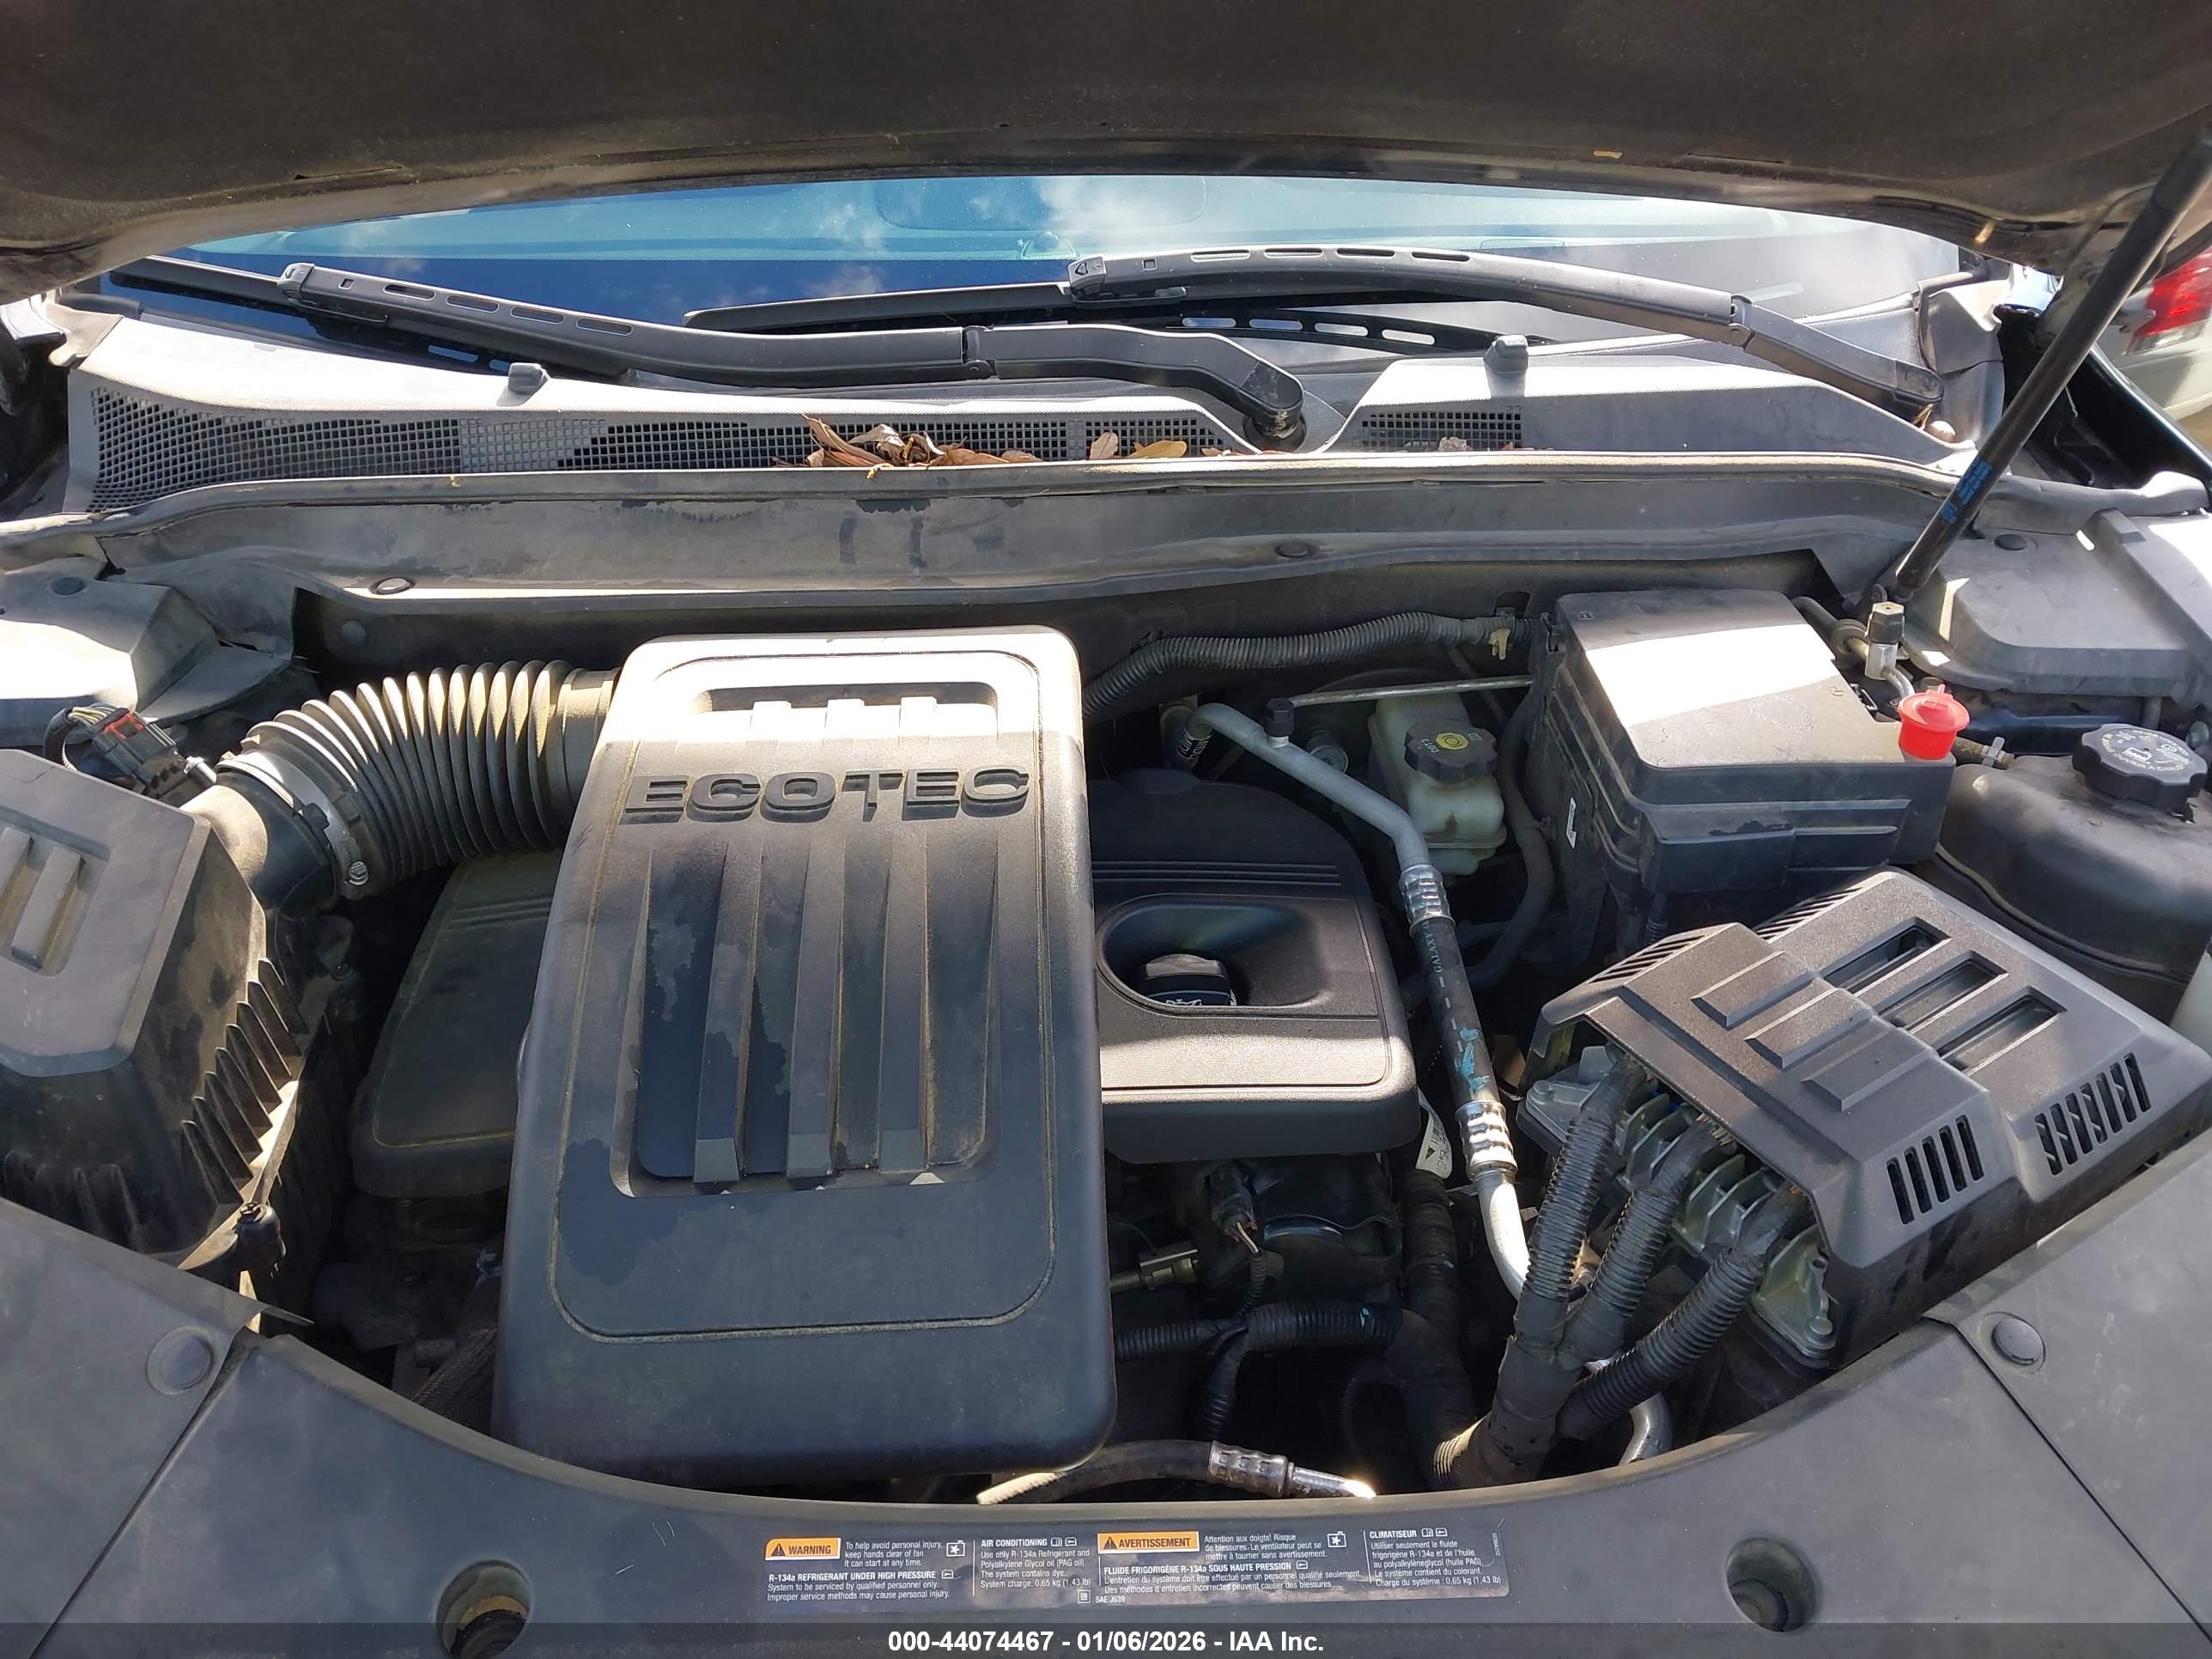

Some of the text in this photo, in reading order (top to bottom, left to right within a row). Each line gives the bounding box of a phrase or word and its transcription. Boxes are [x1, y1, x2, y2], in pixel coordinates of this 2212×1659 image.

[623, 765, 1029, 818] ECOTEC
[1425, 933, 1443, 973] GALAXY
[1273, 1534, 1296, 1542] Risque
[1370, 1530, 1417, 1539] CLIMATISEUR
[892, 1541, 921, 1550] personal
[1119, 1538, 1191, 1548] AVERTISSEMENT
[788, 1546, 831, 1554] WARNING
[845, 1551, 861, 1559] keep
[996, 1551, 1009, 1559] only
[981, 1561, 1022, 1570] Polyalkylene
[1024, 1560, 1046, 1570] Glycol
[1056, 1559, 1073, 1567] (PAG
[1104, 1566, 1129, 1575] FLUIDE
[1231, 1563, 1254, 1571] HAUTE
[1255, 1562, 1291, 1571] PRESSION
[798, 1572, 848, 1581] REFRIGERANT
[1052, 1569, 1066, 1578] dye.
[1104, 1576, 1139, 1584] L'entretien
[1152, 1574, 1180, 1584] système
[1182, 1573, 1195, 1583] doit
[1196, 1573, 1210, 1582] être
[1265, 1572, 1297, 1581] personnel
[1299, 1571, 1323, 1580] qualifié
[1325, 1570, 1361, 1578] seulement.
[1384, 1569, 1413, 1578] système
[768, 1583, 793, 1592] System
[816, 1582, 844, 1590] serviced
[846, 1582, 854, 1590] by
[888, 1581, 921, 1589] personnel
[923, 1580, 938, 1589] only.
[1007, 1579, 1032, 1589] charge:
[1053, 1579, 1060, 1588] kg
[1082, 1578, 1091, 1587] lb)
[1376, 1579, 1400, 1588] Charge
[1413, 1578, 1440, 1588] système
[1462, 1577, 1471, 1586] kg
[1492, 1576, 1501, 1584] lb)
[1104, 1585, 1118, 1594] Des
[1120, 1584, 1152, 1593] méthodes
[1193, 1582, 1230, 1591] incorrectes
[1231, 1582, 1259, 1591] peuvent
[768, 1593, 798, 1601] Improper
[898, 1591, 927, 1600] personal
[930, 1590, 950, 1599] injury.
